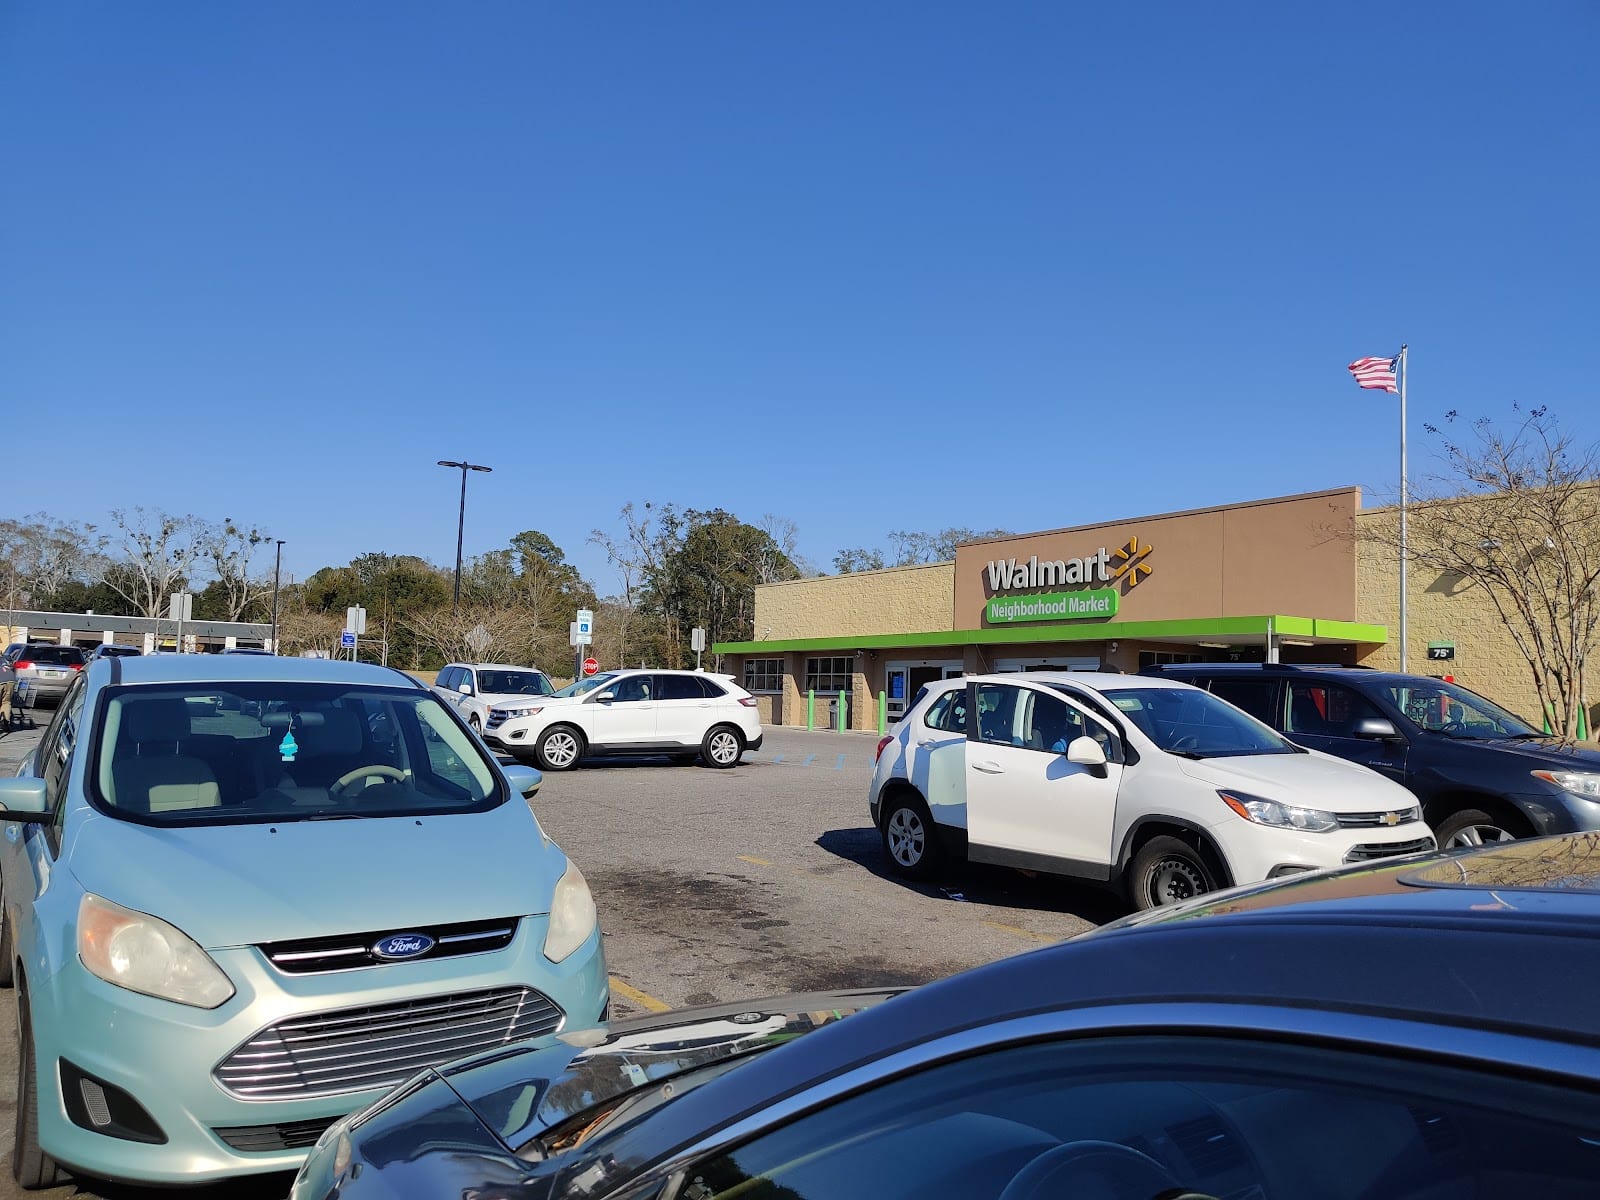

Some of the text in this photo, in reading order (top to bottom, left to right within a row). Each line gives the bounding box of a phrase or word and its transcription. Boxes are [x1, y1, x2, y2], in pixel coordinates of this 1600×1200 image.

[987, 547, 1110, 591] Walmart
[991, 596, 1109, 620] Neighborhood Market
[388, 937, 421, 953] Ford
